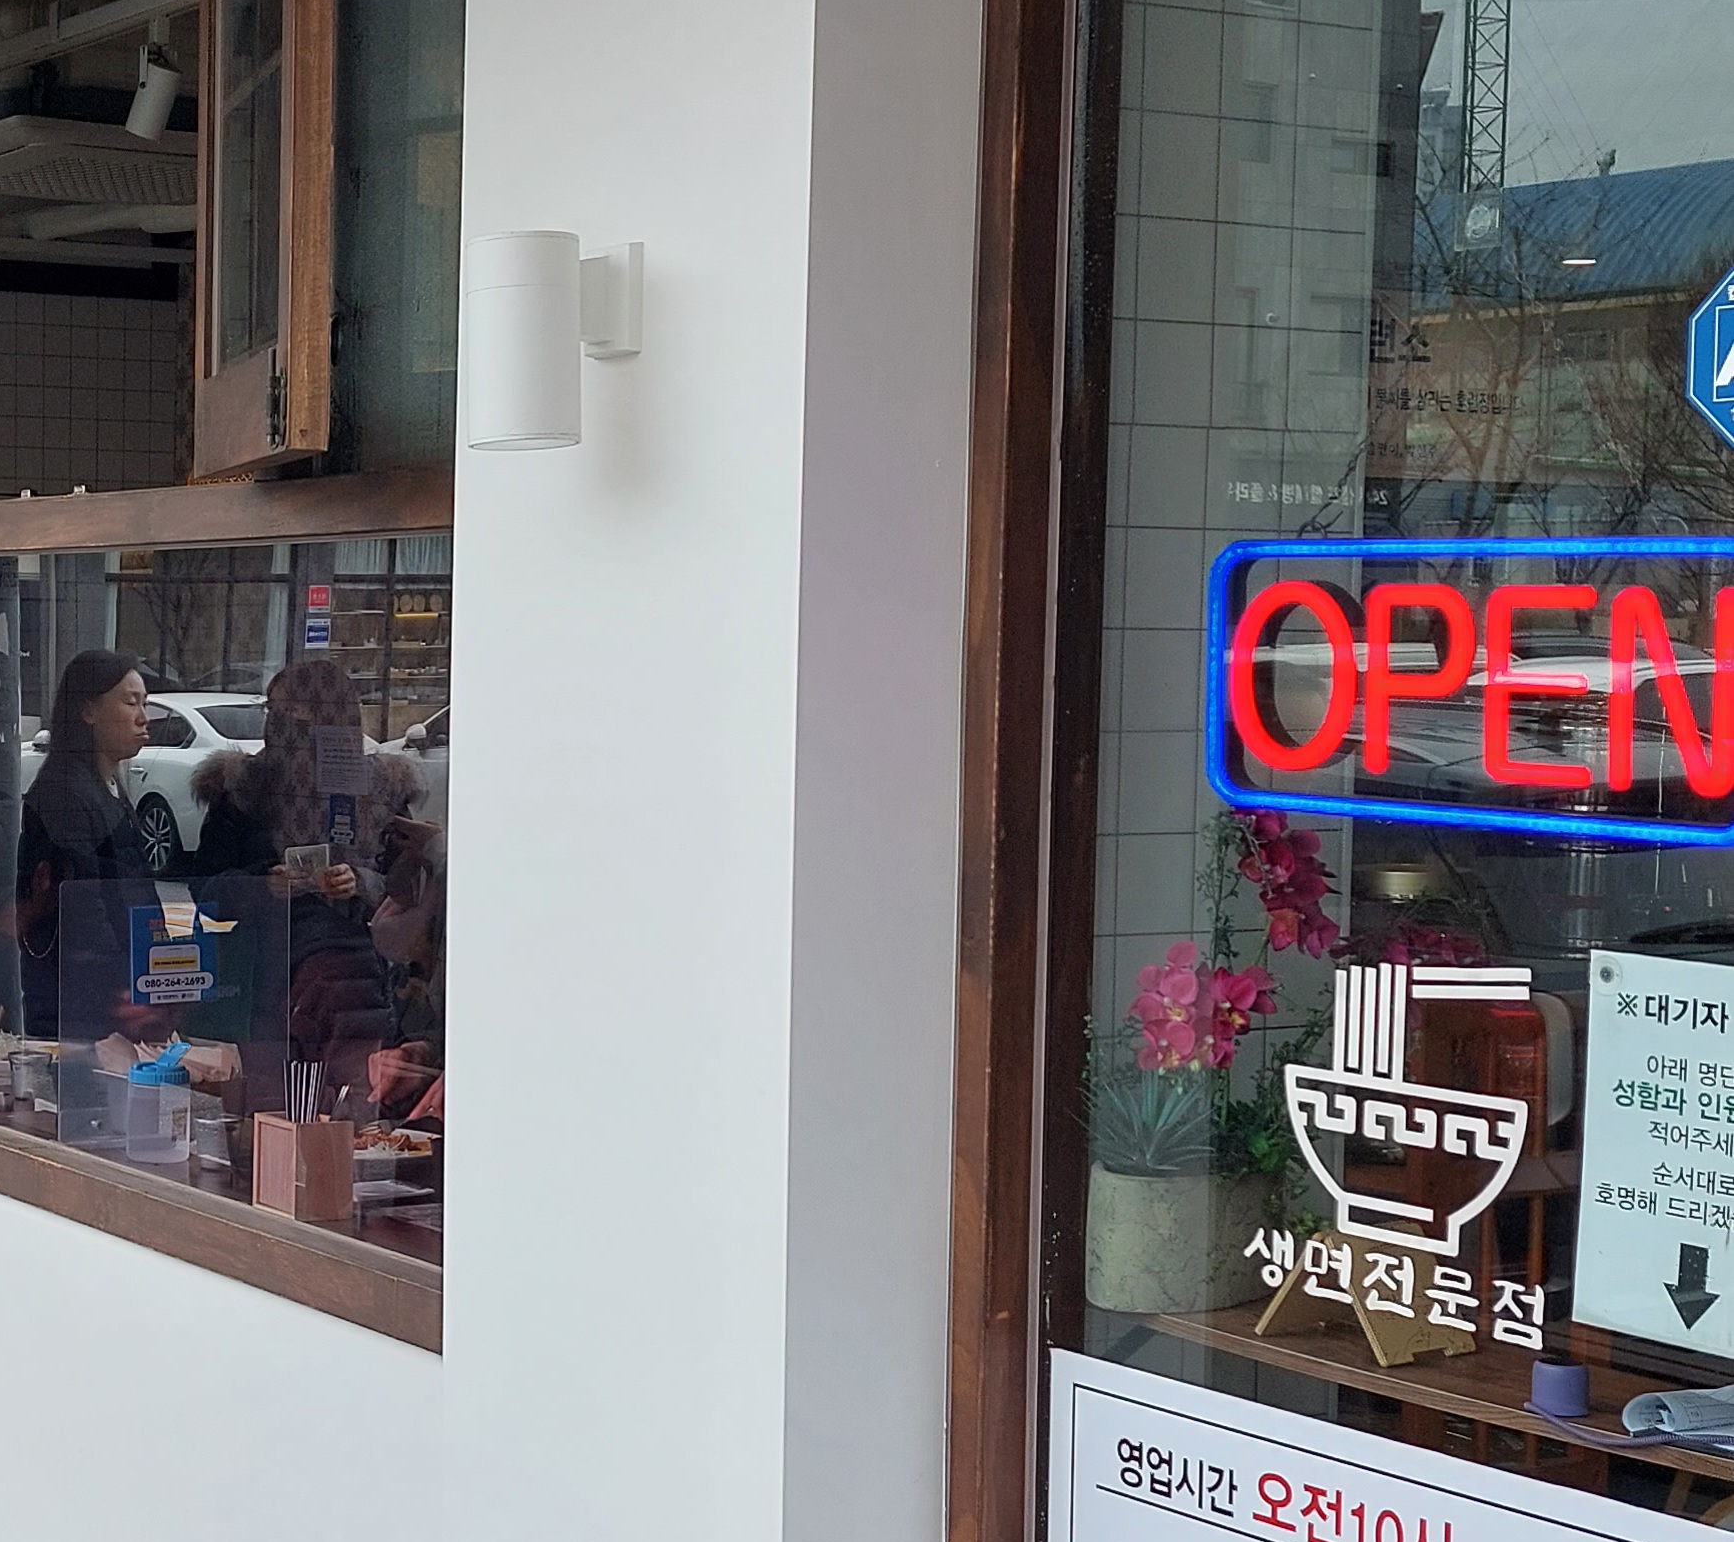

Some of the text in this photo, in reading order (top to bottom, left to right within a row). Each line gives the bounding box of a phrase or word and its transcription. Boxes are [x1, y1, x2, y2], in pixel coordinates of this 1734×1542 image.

[1231, 579, 1734, 797] OPEN
[1645, 994, 1729, 1034] 대기자
[1647, 1055, 1687, 1082] 아래
[1613, 1079, 1687, 1116] 성함과
[1595, 1182, 1734, 1230] 호명해 드리겠
[1244, 1227, 1544, 1350] 생면전문점
[1116, 1436, 1238, 1518] 영업시간
